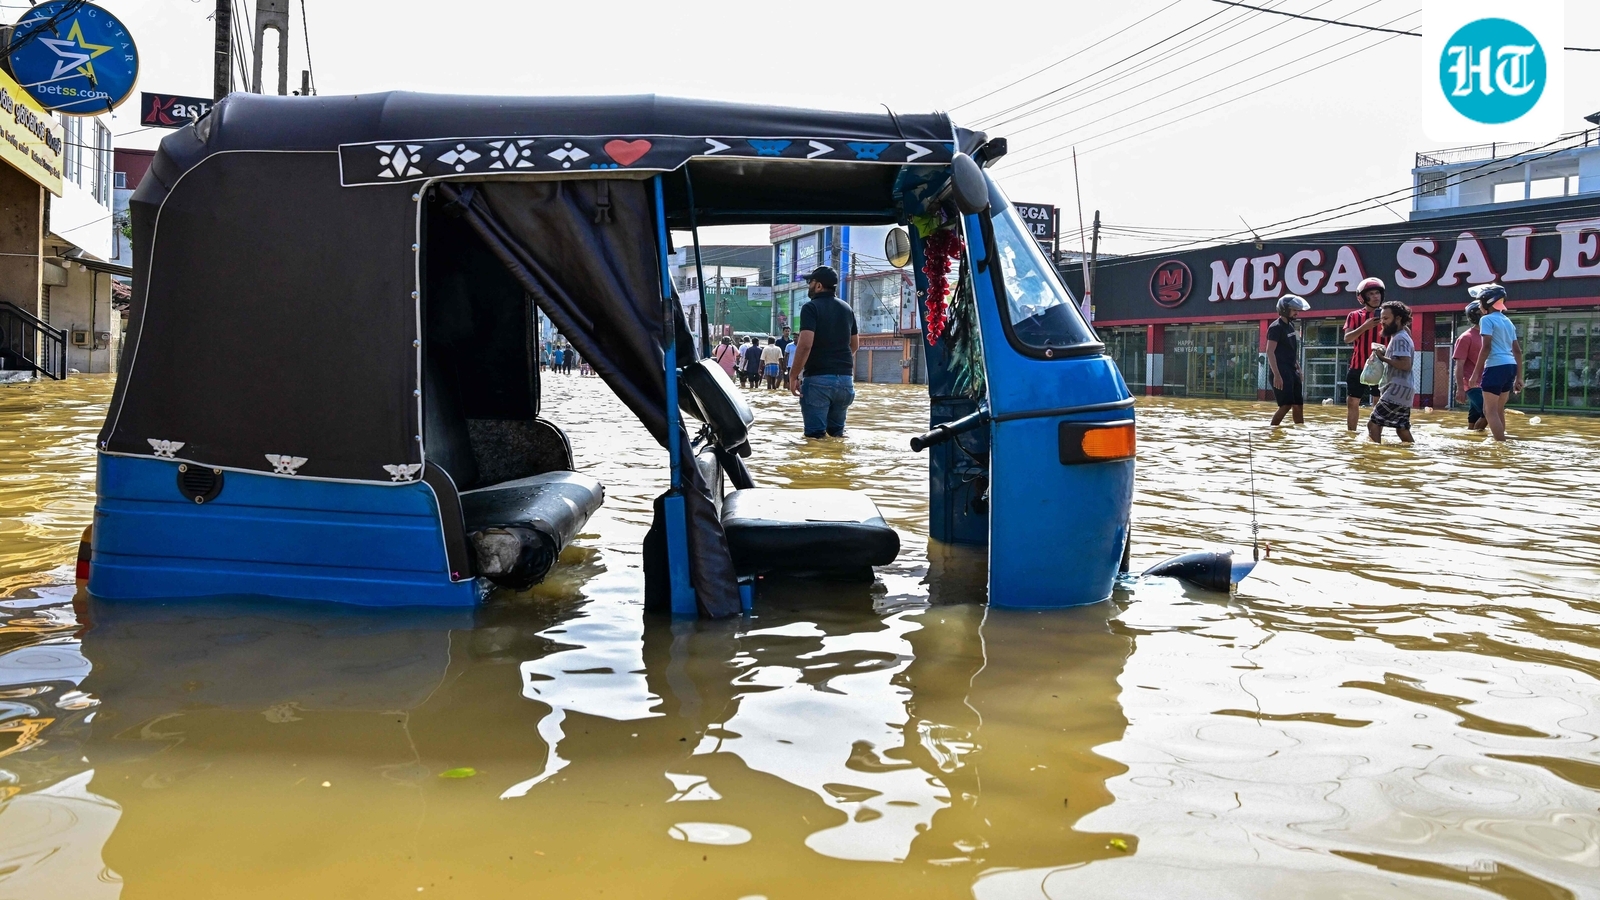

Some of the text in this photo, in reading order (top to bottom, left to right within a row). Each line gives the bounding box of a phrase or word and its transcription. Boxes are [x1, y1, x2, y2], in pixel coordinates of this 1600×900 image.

[12, 3, 134, 61] PORTG STAR
[37, 84, 108, 98] betss.com
[1207, 218, 1600, 302] MEGA SALE
